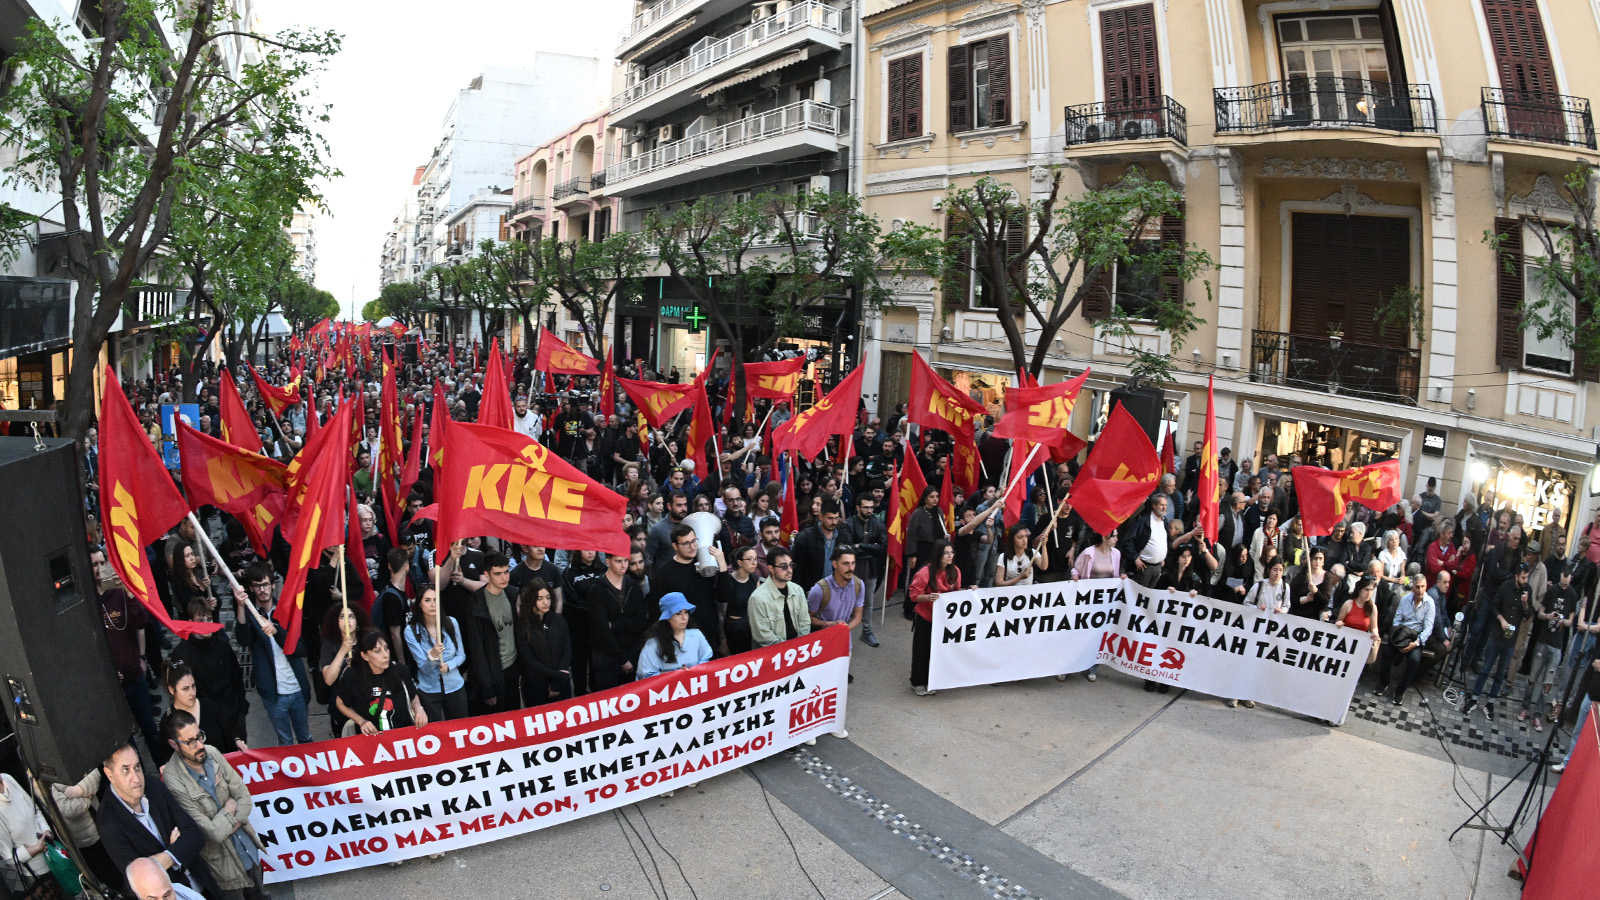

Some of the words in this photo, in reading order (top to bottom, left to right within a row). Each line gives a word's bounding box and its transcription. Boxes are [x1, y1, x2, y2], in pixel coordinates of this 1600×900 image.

[462, 464, 587, 524] ΚΚΕ
[942, 623, 977, 644] ΜΕ
[985, 608, 1121, 640] ΑΝΥΠΑΚΟΗ
[1127, 614, 1171, 638] ΚΑΙ
[1177, 624, 1247, 656] ΠΑΛΗ
[1255, 642, 1351, 678] ΤΑΞΙΚΗ!
[945, 600, 972, 619] 90
[979, 592, 1066, 615] ΧΡΟΝΙΑ
[1075, 588, 1126, 606] ΜΕΤΑ
[1135, 593, 1149, 609] Η
[1156, 599, 1245, 630] ΙΣΤΟΡΙΑ
[1253, 617, 1358, 655] ΓΡΑΦΕΤΑΙ
[1099, 631, 1157, 667] ΚΝΕ
[1120, 660, 1180, 682] ΜΑΚΕΔΟΝΙΑΣ
[236, 748, 364, 785] ΧΡΟΝΙΑ
[372, 734, 441, 764] ΑΠΟ
[449, 719, 515, 749] ΤΟΝ
[523, 693, 641, 737] ΗΡΩΙΚΟ
[648, 674, 708, 707] ΜΑΗ
[714, 657, 764, 688] ΤΟΥ
[771, 640, 823, 672] 1936
[789, 693, 837, 729] ΚΚΕ
[255, 797, 294, 818] ΤΟ
[303, 786, 364, 811] ΚΚΕ
[371, 757, 513, 802] ΜΠΡΟΣΤΑ
[523, 728, 635, 769] ΚΟΝΤΡΑ
[643, 713, 693, 740] ΣΤΟ
[701, 676, 805, 724] ΣΥΣΤΗΜΑ
[286, 804, 431, 842] ΠΟΛΕΜΩΝ
[442, 790, 492, 815] ΚΑΙ
[500, 775, 555, 802] ΤΗΣ
[563, 709, 775, 787] ΕΚΜΕΤΑΛΛΕΥΣΗΣ
[277, 850, 315, 870] ΤΟ
[324, 836, 388, 862] ΔΙΚΟ
[396, 823, 454, 848] ΜΑΣ
[459, 796, 578, 836] ΜΕΛΛΟΝ,
[584, 783, 618, 805] ΤΟ
[624, 731, 773, 794] ΣΟΣΙΑΛΙΣΜΟ!
